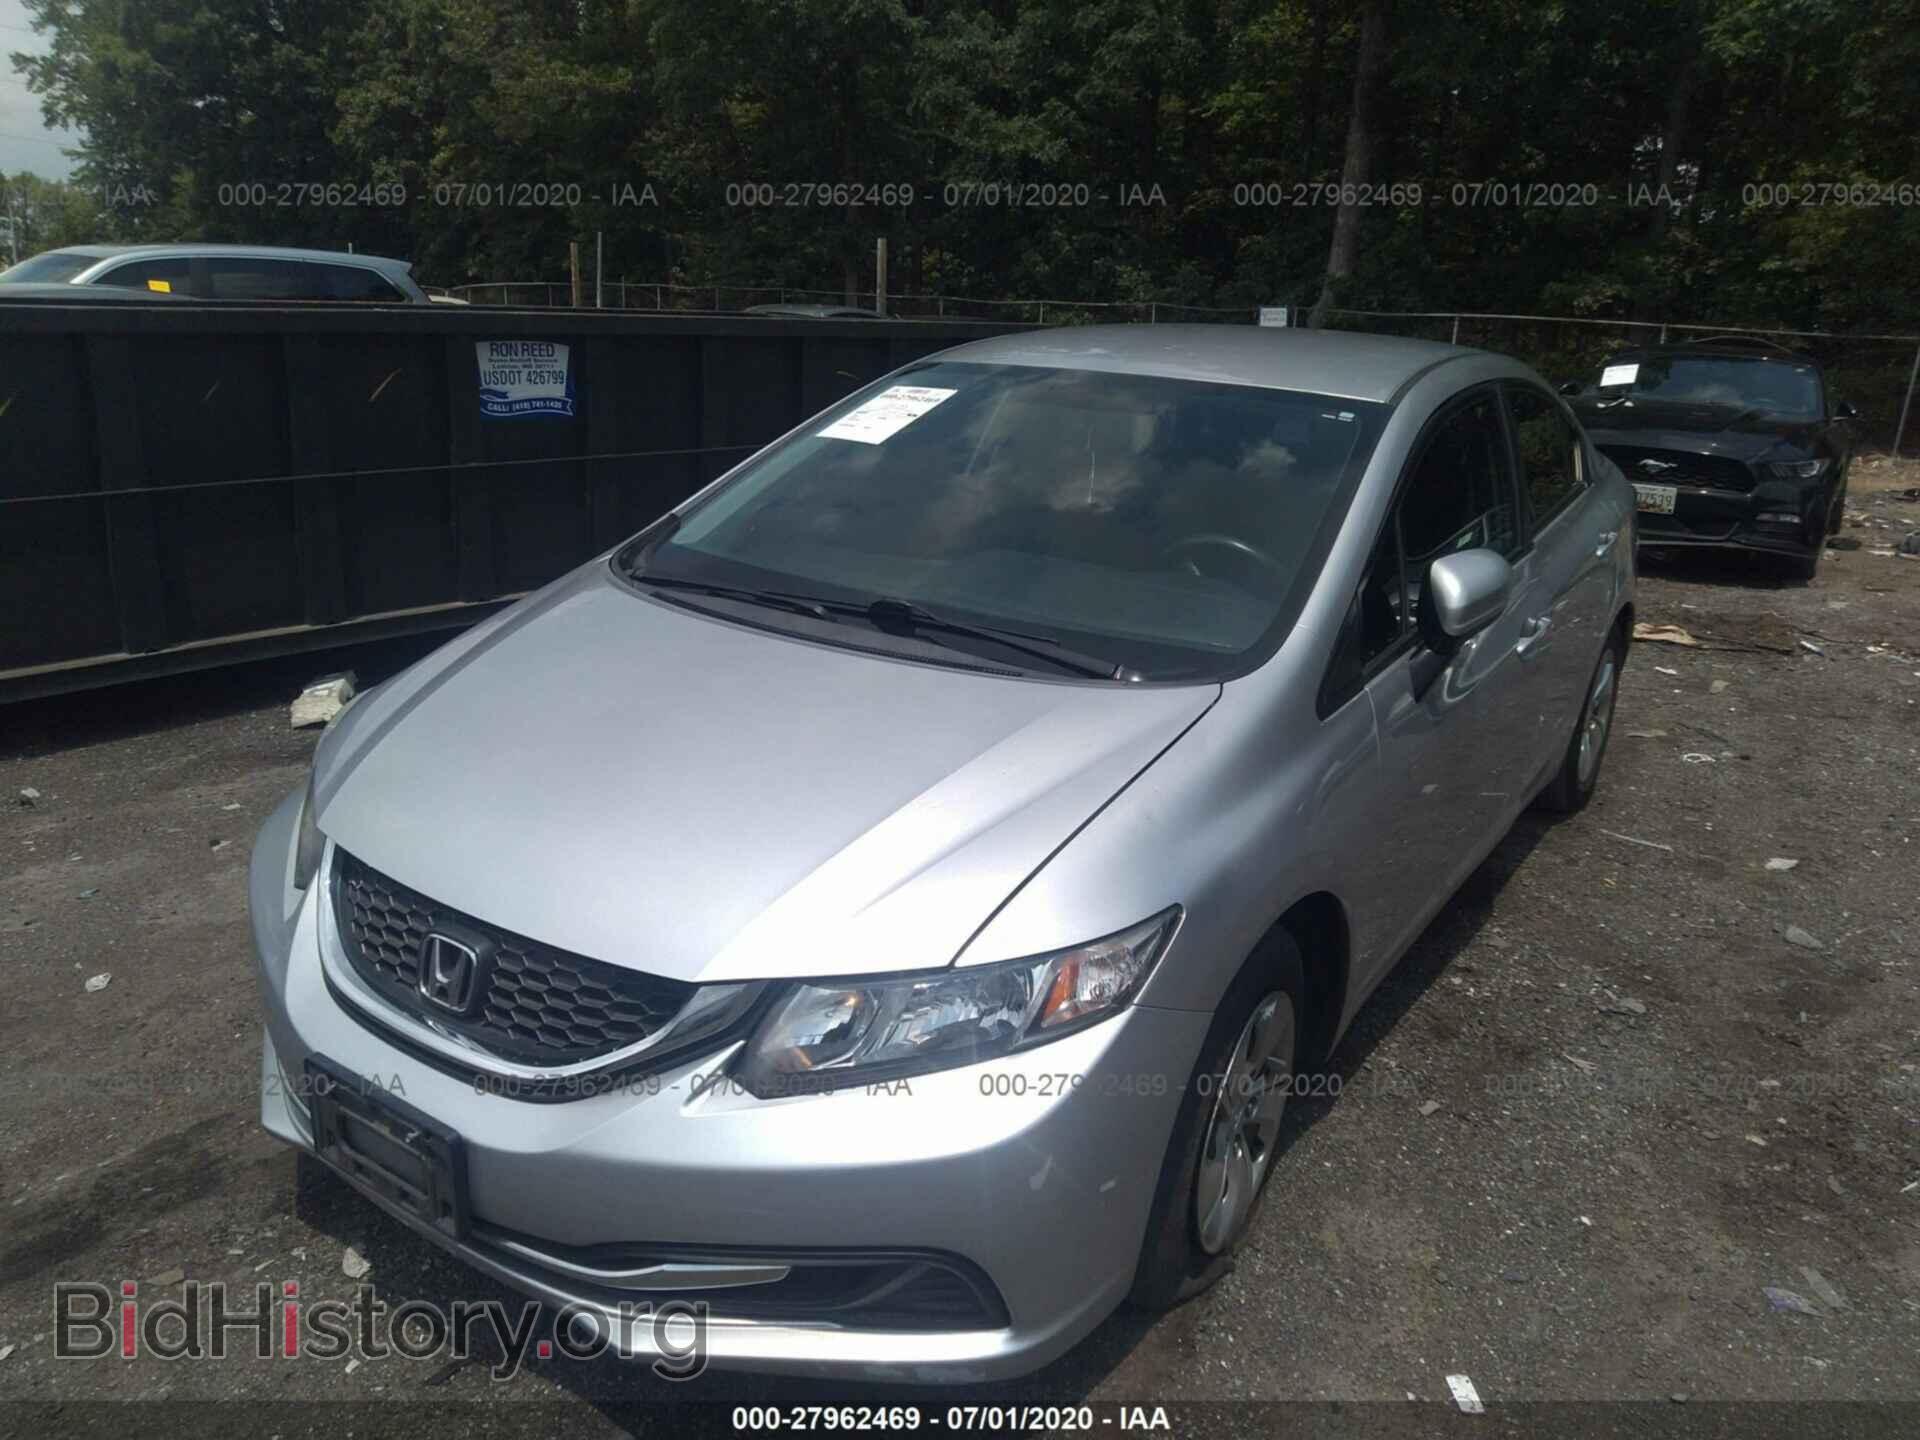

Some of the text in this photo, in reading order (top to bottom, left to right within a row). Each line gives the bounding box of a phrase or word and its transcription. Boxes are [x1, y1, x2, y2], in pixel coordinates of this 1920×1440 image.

[489, 342, 555, 357] RON REED
[483, 369, 564, 386] USDOT 426799
